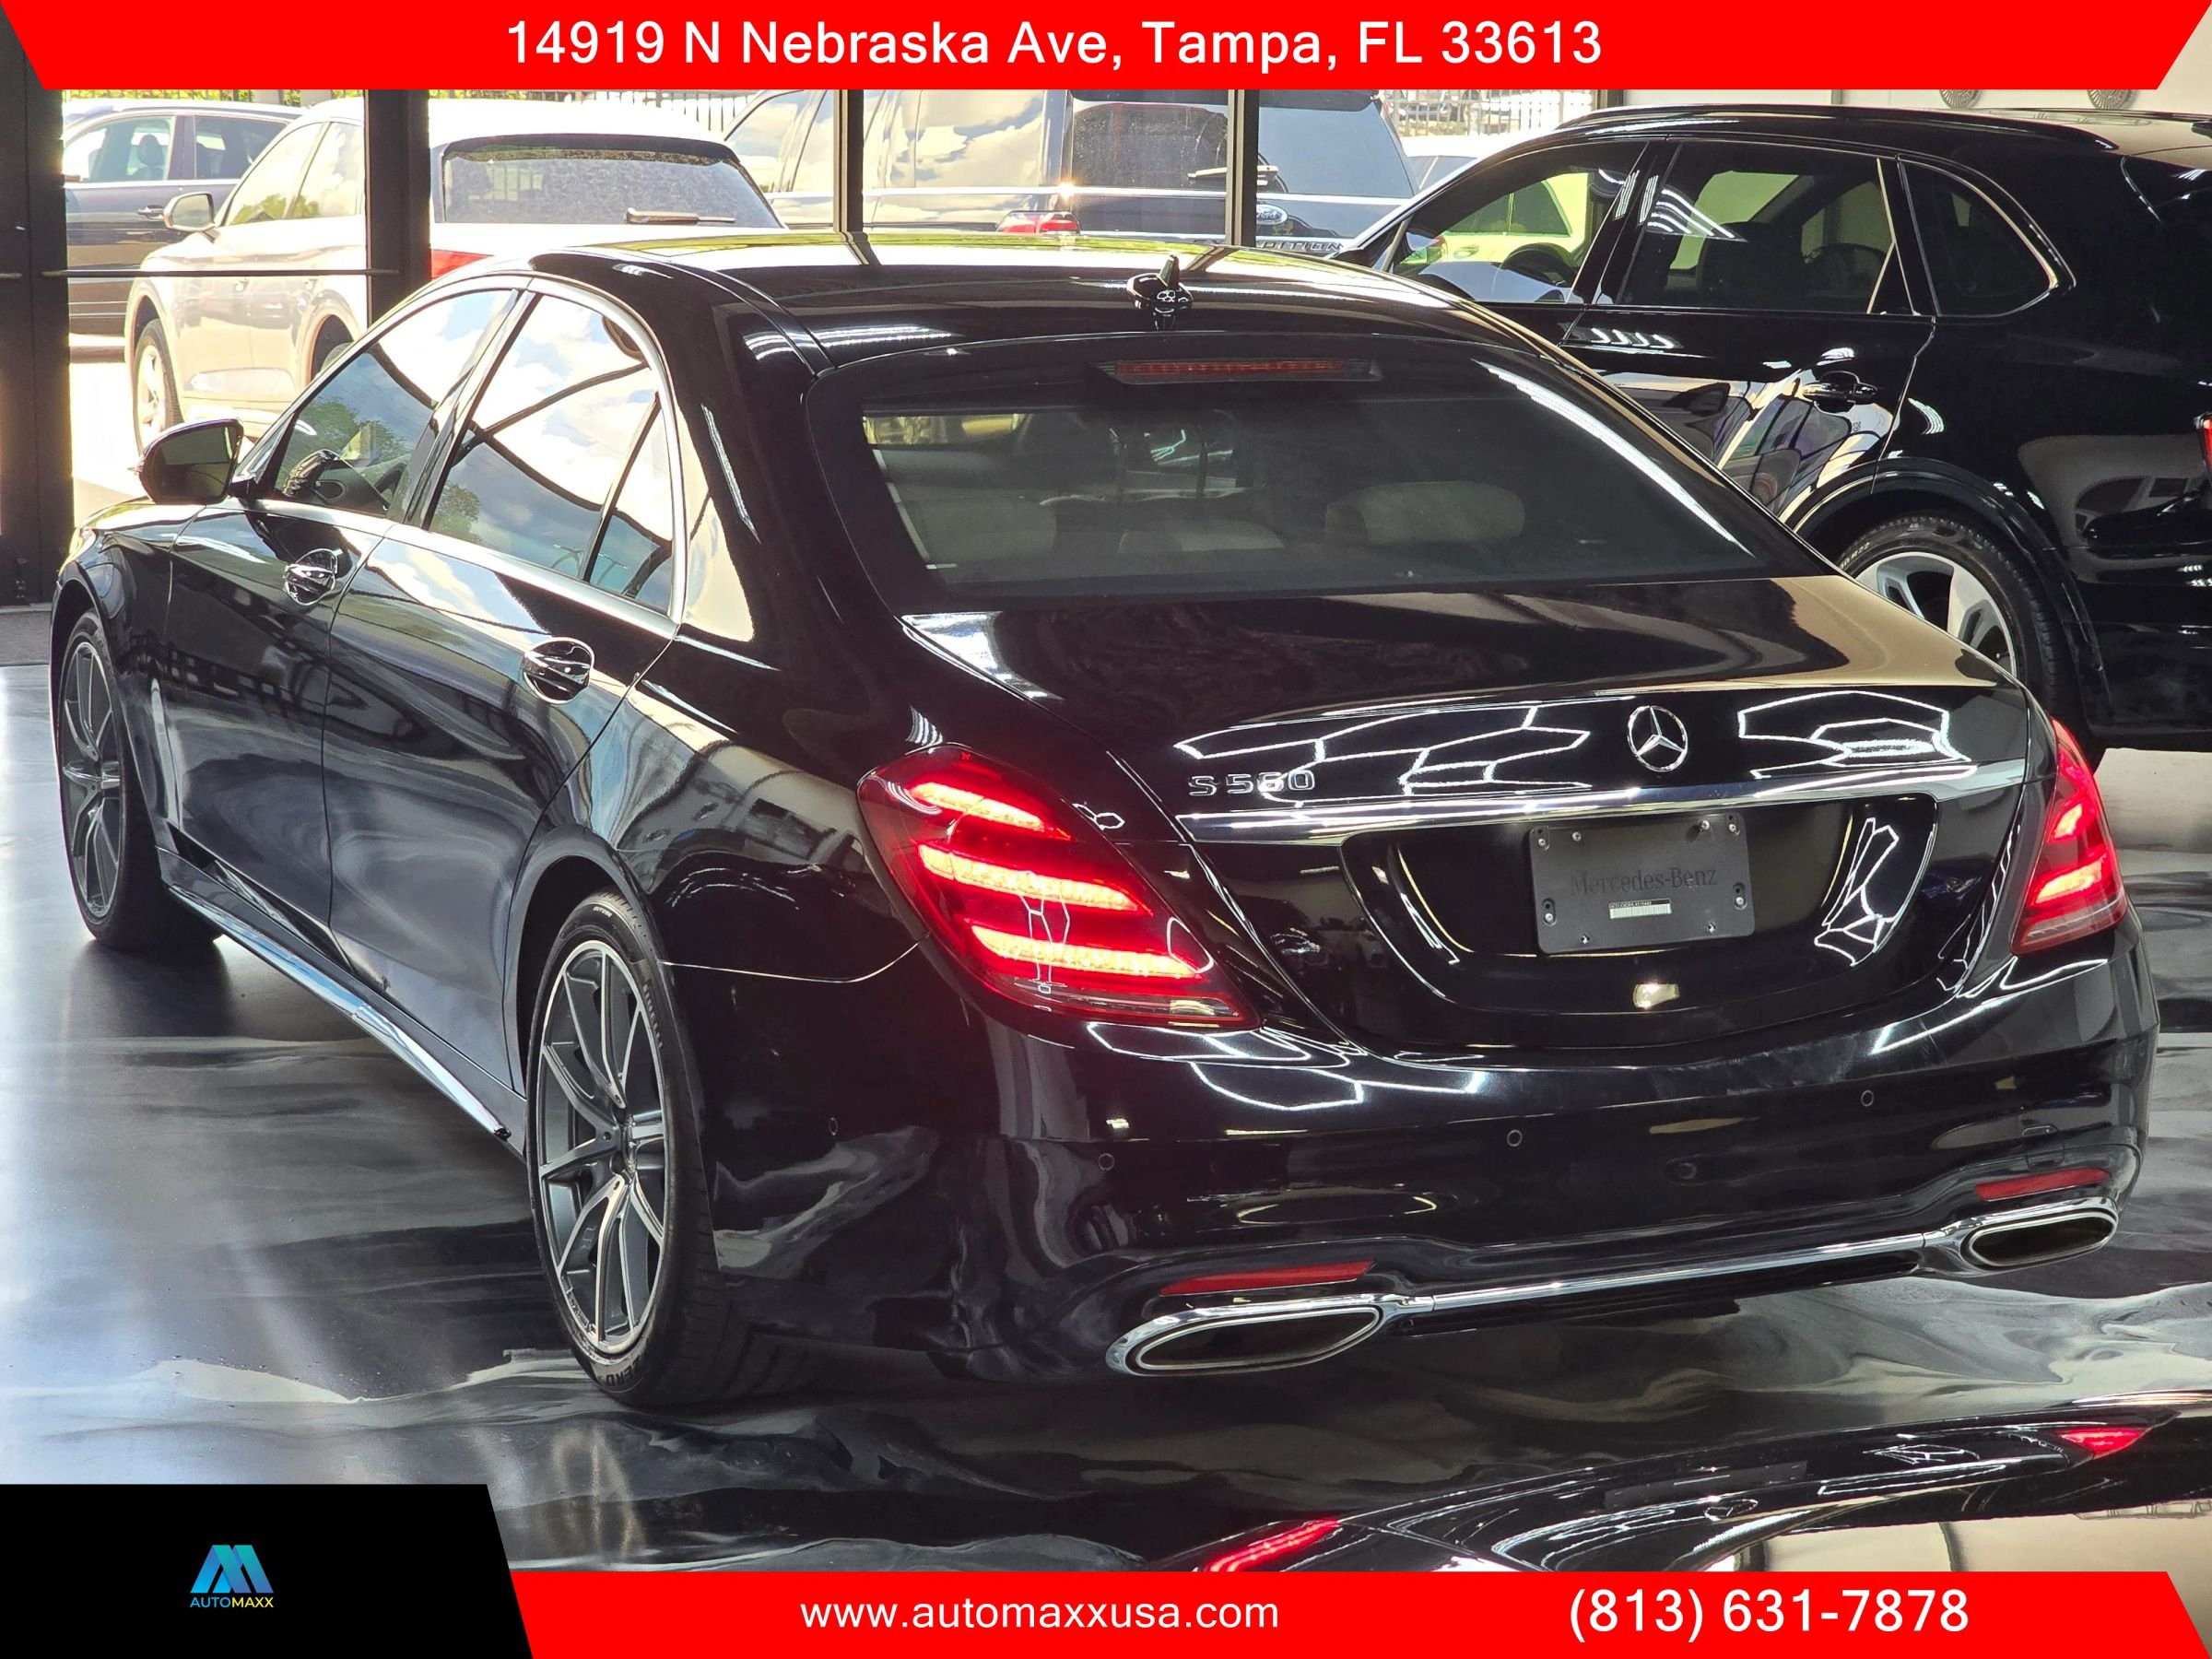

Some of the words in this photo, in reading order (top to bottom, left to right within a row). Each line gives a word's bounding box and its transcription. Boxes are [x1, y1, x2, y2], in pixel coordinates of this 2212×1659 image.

[1188, 775, 1218, 797] S
[1225, 770, 1315, 794] 560
[1570, 866, 1719, 897] Mercedes-Benz
